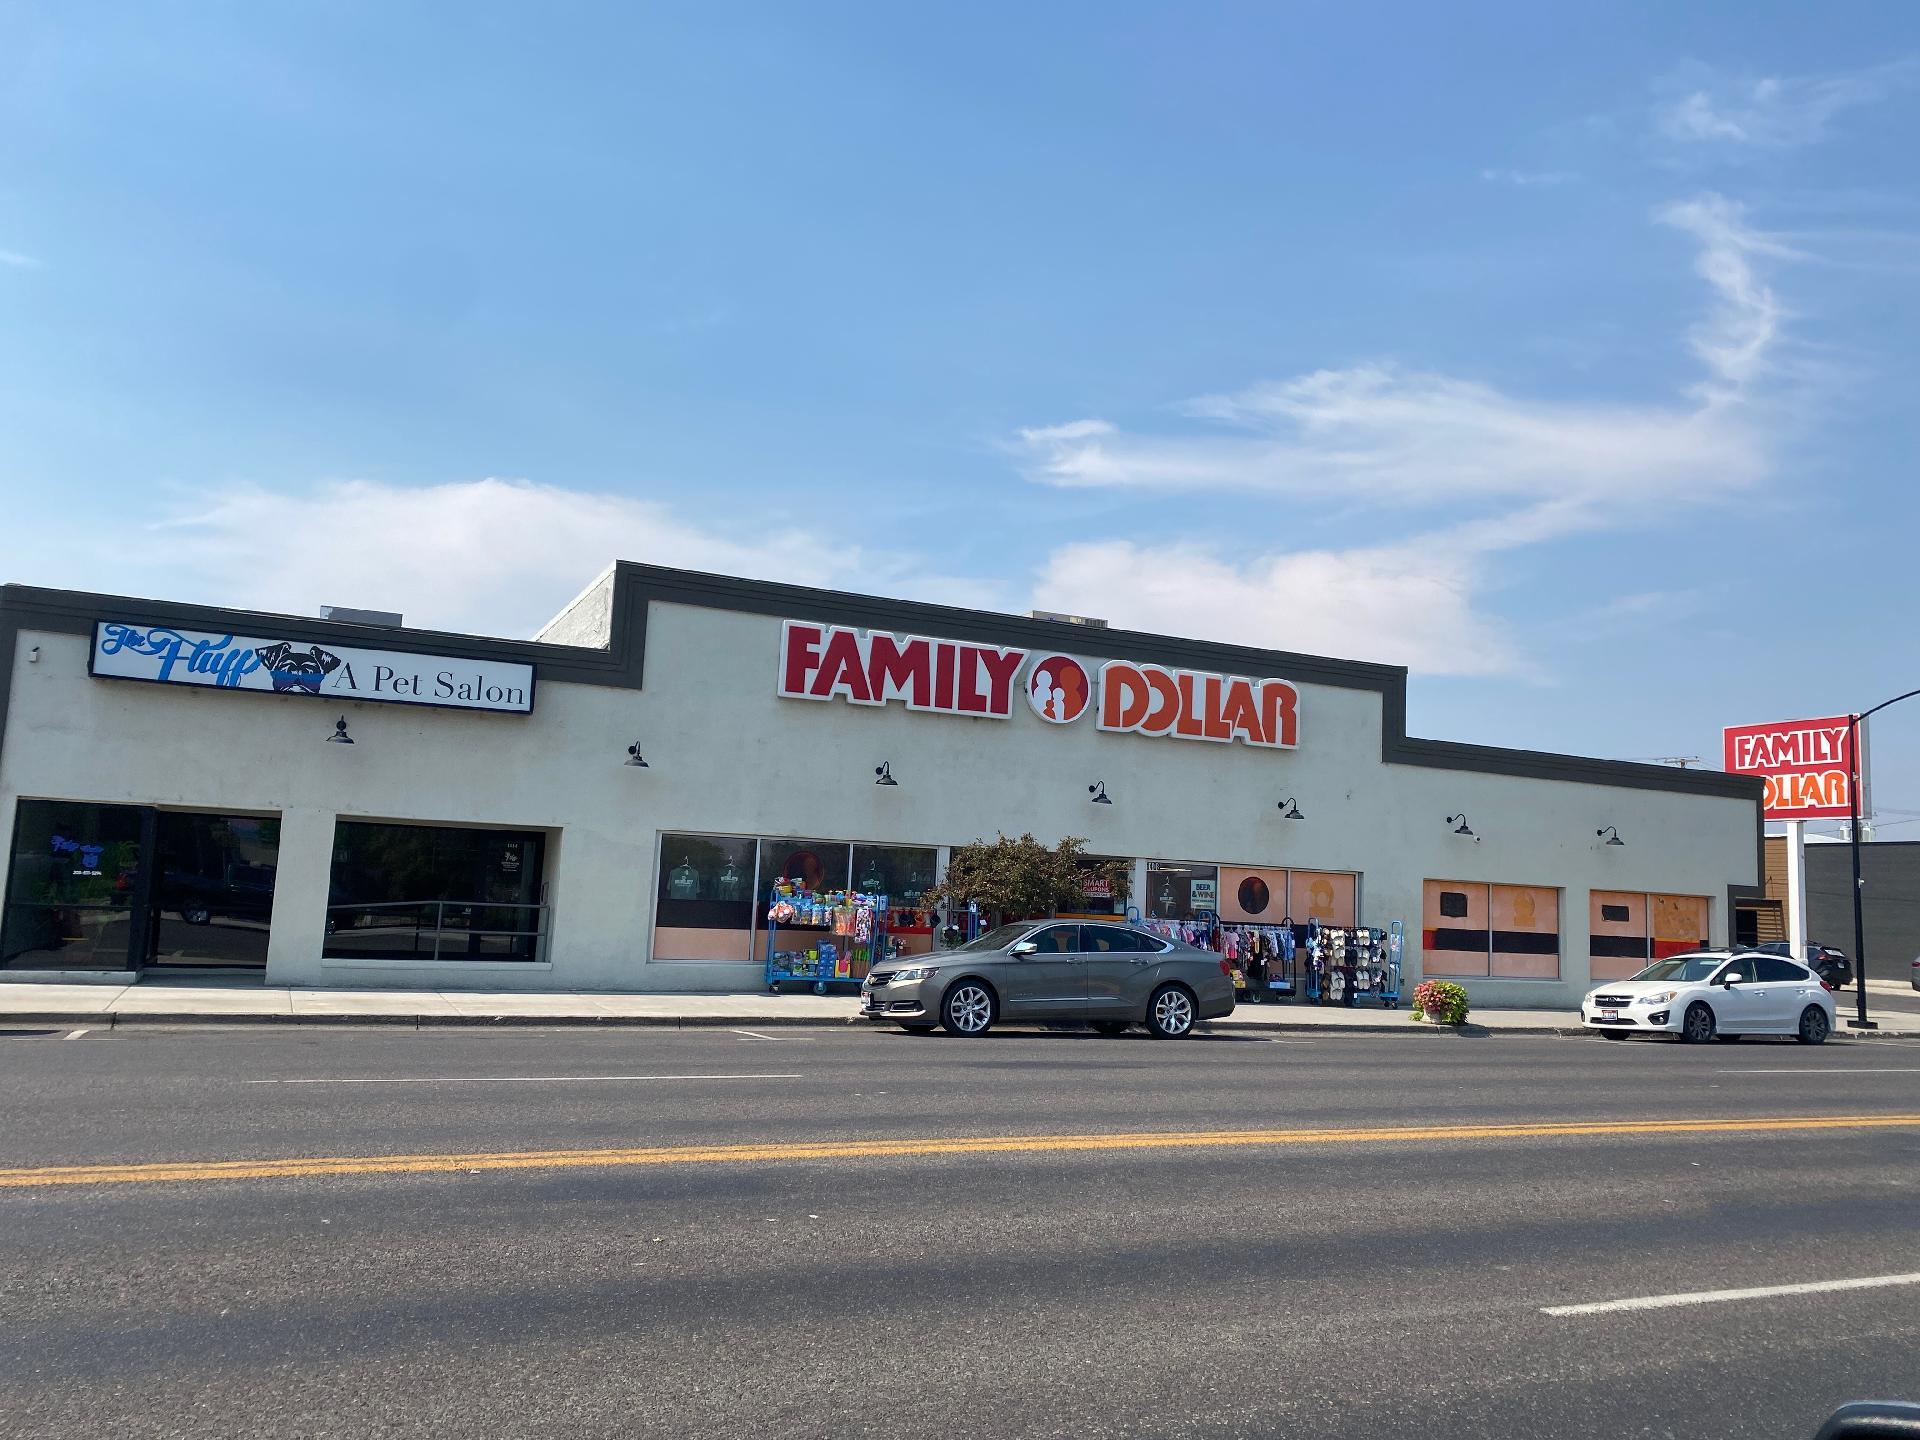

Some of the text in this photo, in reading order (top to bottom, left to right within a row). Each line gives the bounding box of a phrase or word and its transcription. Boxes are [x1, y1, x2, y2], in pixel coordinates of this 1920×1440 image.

[101, 623, 146, 655] The
[331, 662, 360, 691] A
[371, 665, 423, 696] Pet
[434, 671, 525, 705] Salon
[783, 624, 1299, 746] FAMILY DOLLAR
[1735, 727, 1849, 769] FAMILY
[1760, 770, 1848, 810] OLLAR
[1083, 879, 1109, 887] SMART
[1198, 891, 1214, 899] WINE
